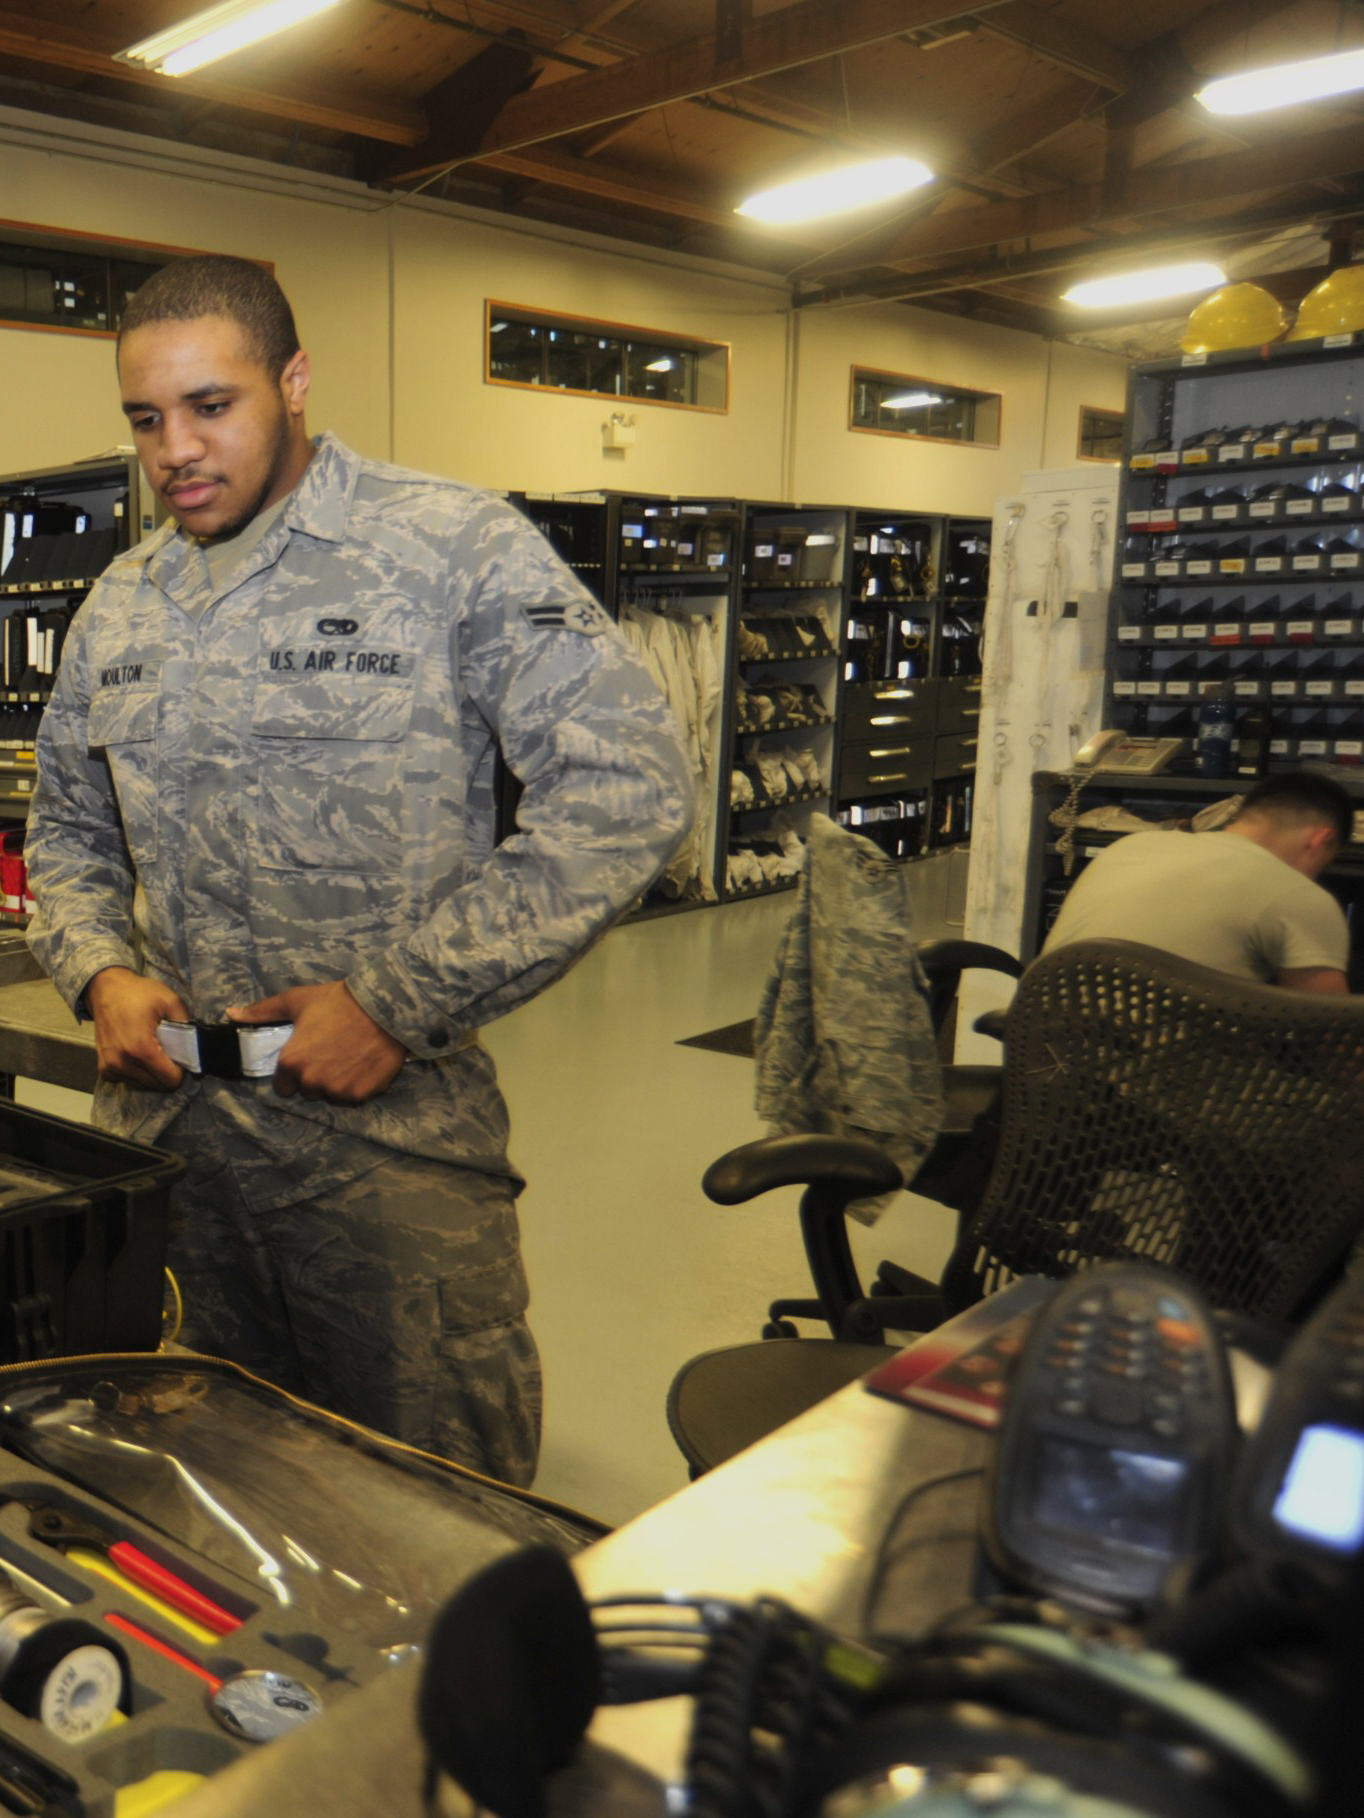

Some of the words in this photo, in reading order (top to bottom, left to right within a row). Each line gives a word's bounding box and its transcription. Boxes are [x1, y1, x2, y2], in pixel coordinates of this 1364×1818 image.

[269, 650, 297, 671] U.S.
[303, 650, 336, 671] AIR
[344, 651, 401, 675] FORCE
